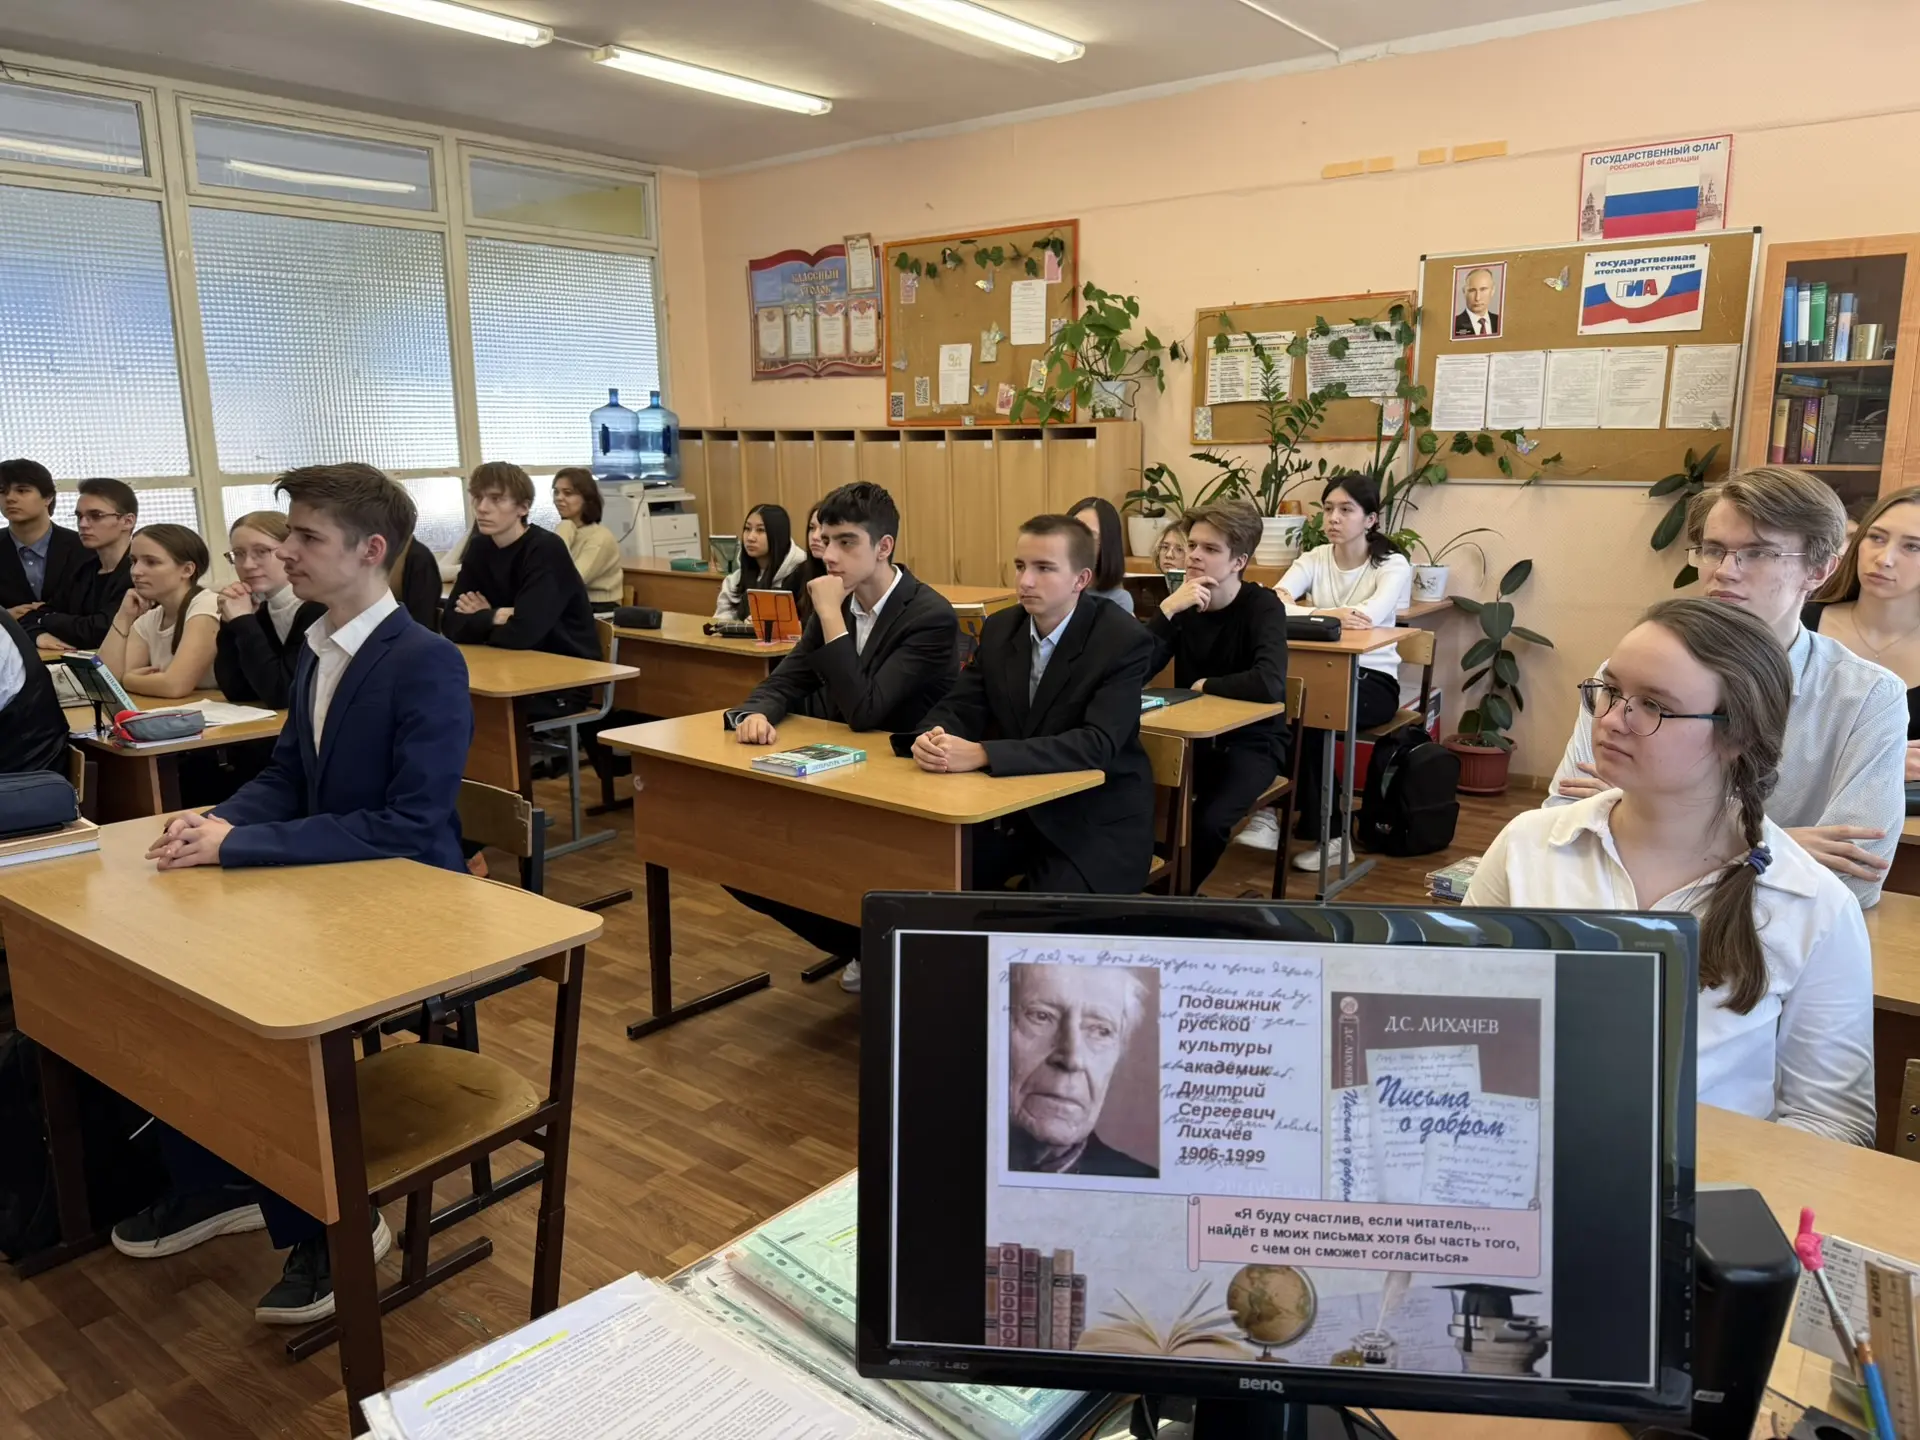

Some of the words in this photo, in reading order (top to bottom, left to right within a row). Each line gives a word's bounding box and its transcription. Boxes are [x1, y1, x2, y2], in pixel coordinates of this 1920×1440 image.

[1590, 144, 1690, 166] ГОСУДАРСТВЕННЫЙ
[1692, 141, 1721, 153] ФЛАГ
[1609, 158, 1655, 171] РОССИЙСКОЙ
[1655, 155, 1700, 167] ФЕДЕРАЦИИ
[1594, 267, 1638, 276] итоговая
[1639, 262, 1695, 272] аттестация
[1595, 254, 1696, 268] государственная
[1616, 278, 1658, 298] ГИА
[1178, 994, 1282, 1012] Подвижник
[1178, 1017, 1251, 1033] русской
[1418, 1016, 1499, 1034] ЛИХАЧЕВ
[1178, 1039, 1273, 1058] культуры
[1183, 1059, 1270, 1077] академик
[1177, 1080, 1266, 1099] Дмитрий
[1376, 1074, 1471, 1109] Письма
[1178, 1102, 1276, 1121] Сергеевич
[1344, 1089, 1358, 1143] Письма
[1400, 1116, 1412, 1132] о
[1419, 1111, 1505, 1144] добром
[1178, 1146, 1266, 1163] 1906-1999
[1235, 1208, 1252, 1219] «Я
[1256, 1209, 1290, 1224] буду
[1294, 1212, 1364, 1227] счастлив,
[1368, 1216, 1403, 1227] если
[1207, 1223, 1255, 1239] найдёт
[1260, 1228, 1268, 1237] в
[1273, 1228, 1309, 1240] моих
[1313, 1230, 1374, 1244] письмах
[1377, 1233, 1410, 1244] хотя
[1414, 1233, 1436, 1245] бы
[1439, 1237, 1481, 1248] часть
[1485, 1238, 1520, 1252] того,
[1251, 1244, 1258, 1253] с
[1262, 1244, 1290, 1255] чем
[1294, 1245, 1311, 1256] он
[1315, 1247, 1366, 1259] сможет
[1372, 1249, 1469, 1264] согласиться»
[1239, 1377, 1285, 1394] BenQ
